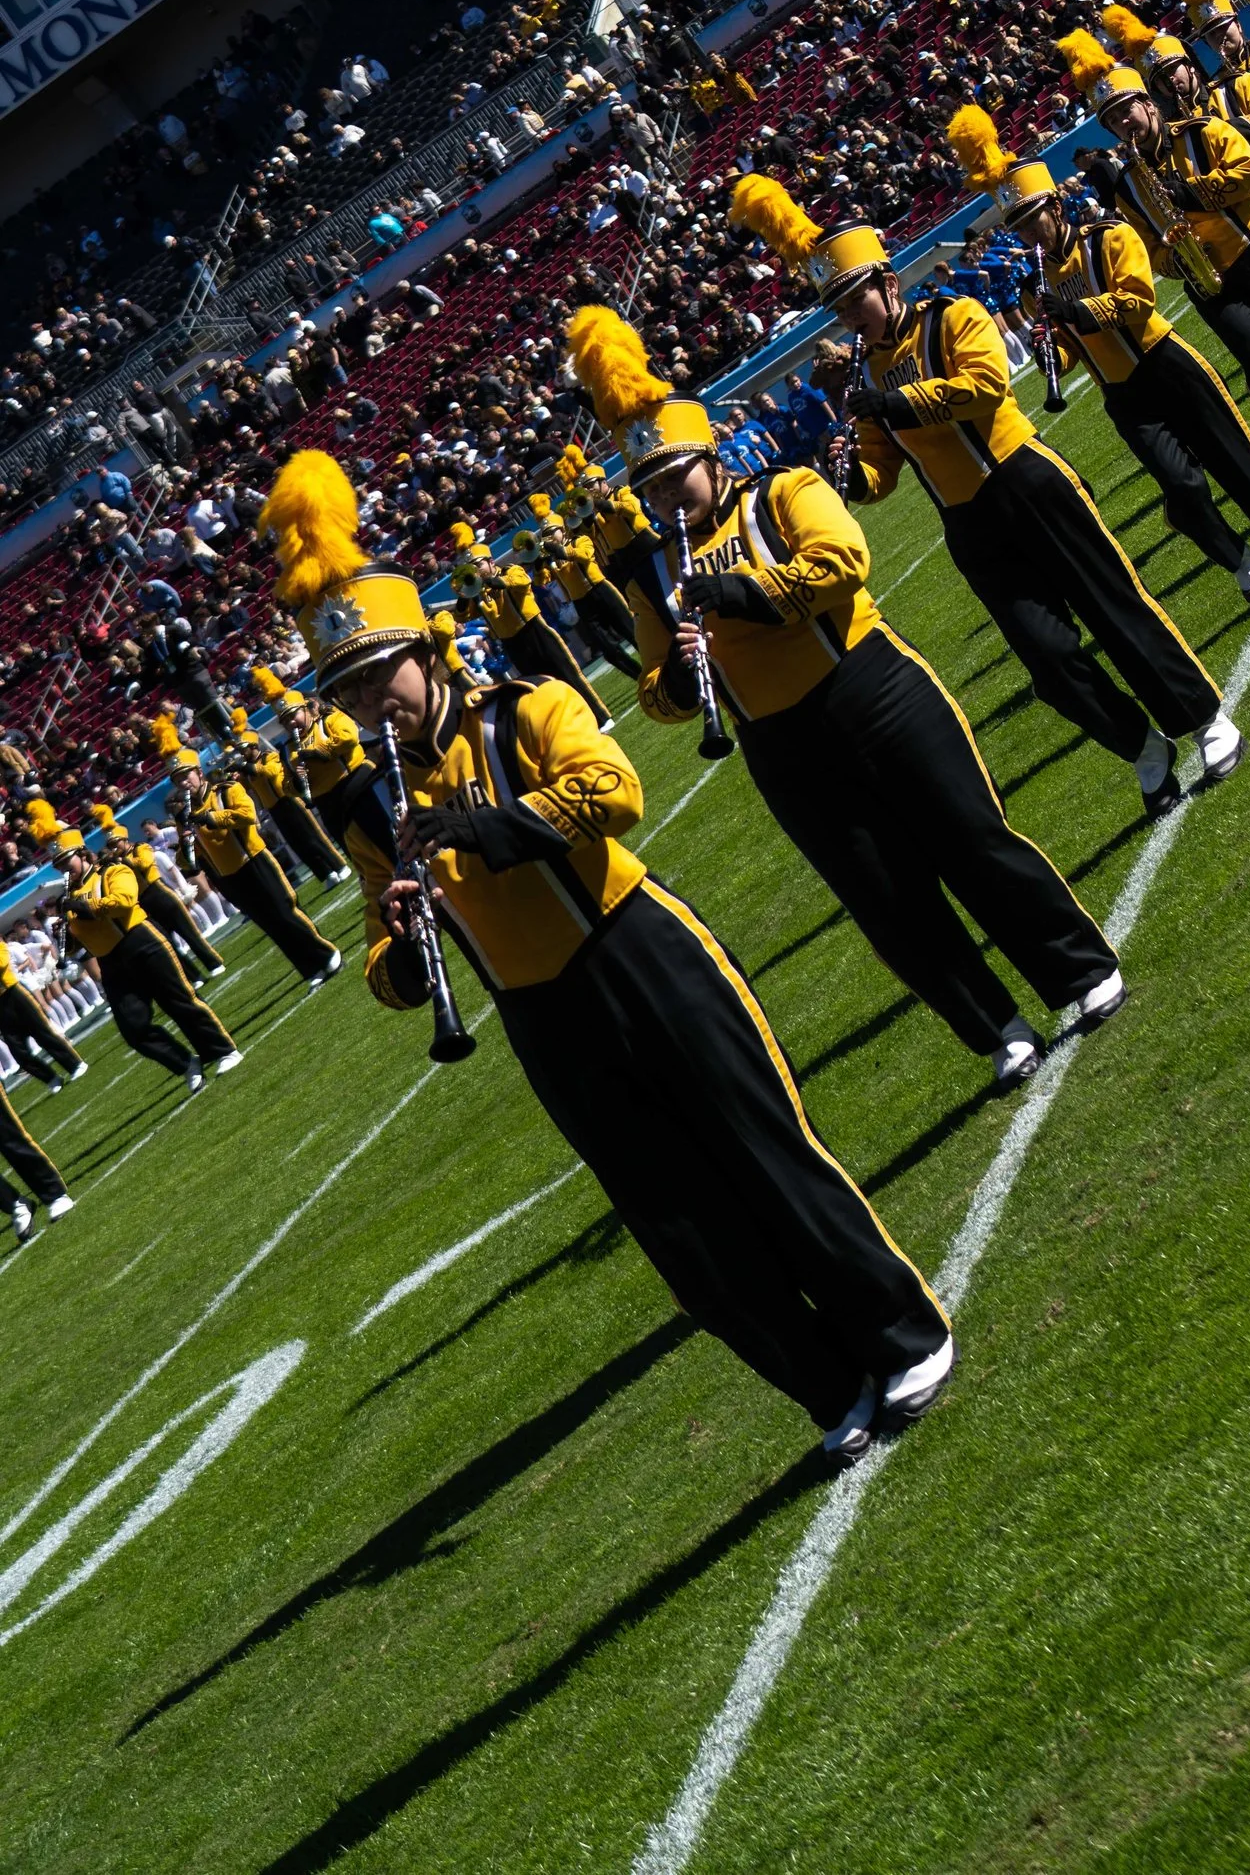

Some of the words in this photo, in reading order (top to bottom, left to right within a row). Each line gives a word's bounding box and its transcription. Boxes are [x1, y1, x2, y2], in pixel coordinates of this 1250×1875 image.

[1056, 271, 1089, 303] IOWA
[881, 352, 922, 392] IOWA
[757, 574, 793, 616] HAWKEYES
[528, 791, 583, 843] HAWKEYES
